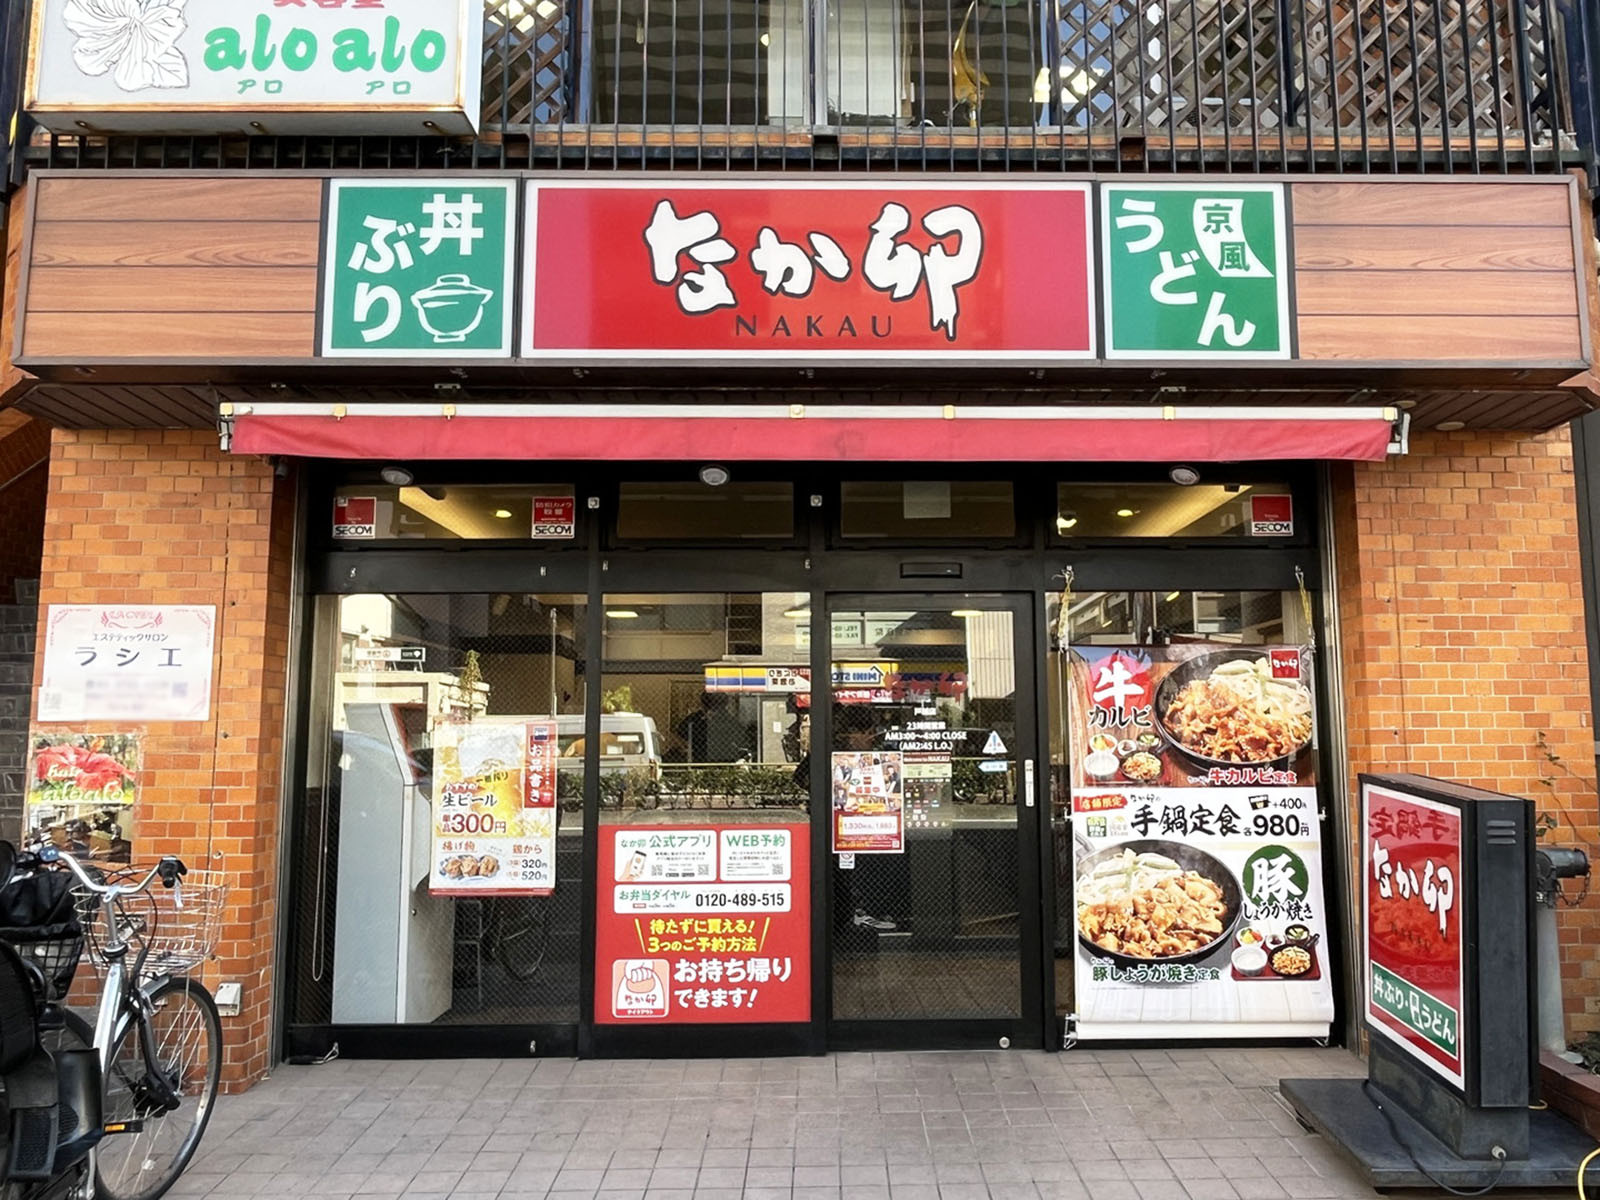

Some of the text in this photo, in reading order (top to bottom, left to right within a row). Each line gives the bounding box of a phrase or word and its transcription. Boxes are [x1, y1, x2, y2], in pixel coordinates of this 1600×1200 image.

[204, 14, 446, 73] alo alo
[237, 79, 411, 95] アロ アロ
[1202, 203, 1250, 272] 京風
[644, 199, 984, 341] なか卯
[1115, 198, 1256, 347] うどん
[735, 315, 892, 337] NAKAU
[335, 526, 372, 534] SECOM
[535, 525, 572, 534] SECOM
[1255, 523, 1290, 531] SECOM
[75, 646, 182, 667] ラシエ
[1093, 661, 1144, 707] 牛
[1089, 705, 1151, 728] カルビ
[942, 731, 967, 740] CLOSE
[1209, 767, 1297, 784] 牛カルビ定食
[443, 793, 497, 808] 生ビール
[451, 813, 506, 833] 300円
[1130, 803, 1241, 837] 手鍋定食
[649, 834, 711, 848] 公式アプリ
[726, 834, 785, 847] WEB予約
[1251, 853, 1304, 903] 豚
[619, 889, 691, 901] お弁当ダイヤル
[1373, 839, 1454, 939] なか卯
[695, 893, 784, 907] 0120-489-515
[647, 936, 757, 953] 3つのご予約方法
[673, 957, 792, 983] お持ち帰り
[1092, 965, 1220, 982] 豚しょうが焼き定食
[673, 987, 758, 1009] できます!
